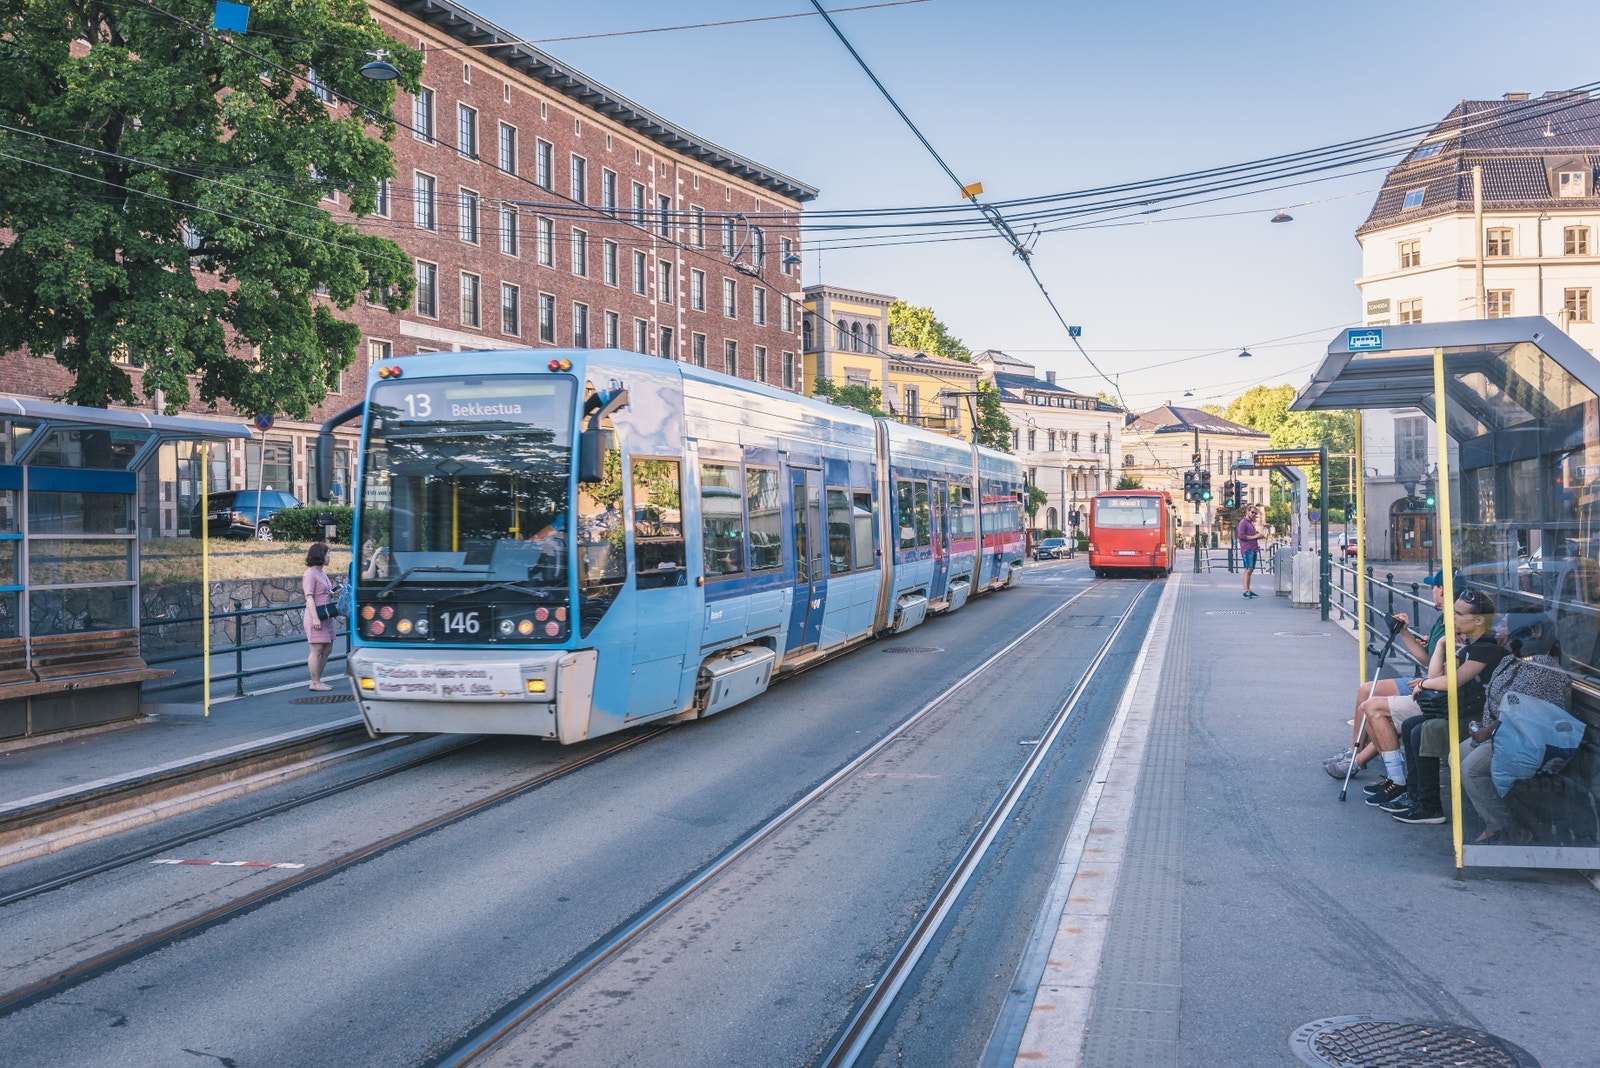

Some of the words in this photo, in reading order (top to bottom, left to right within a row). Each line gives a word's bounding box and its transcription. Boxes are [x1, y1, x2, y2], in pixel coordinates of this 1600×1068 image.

[404, 393, 432, 418] 13
[451, 402, 522, 417] Bekkestua
[440, 611, 480, 634] 146
